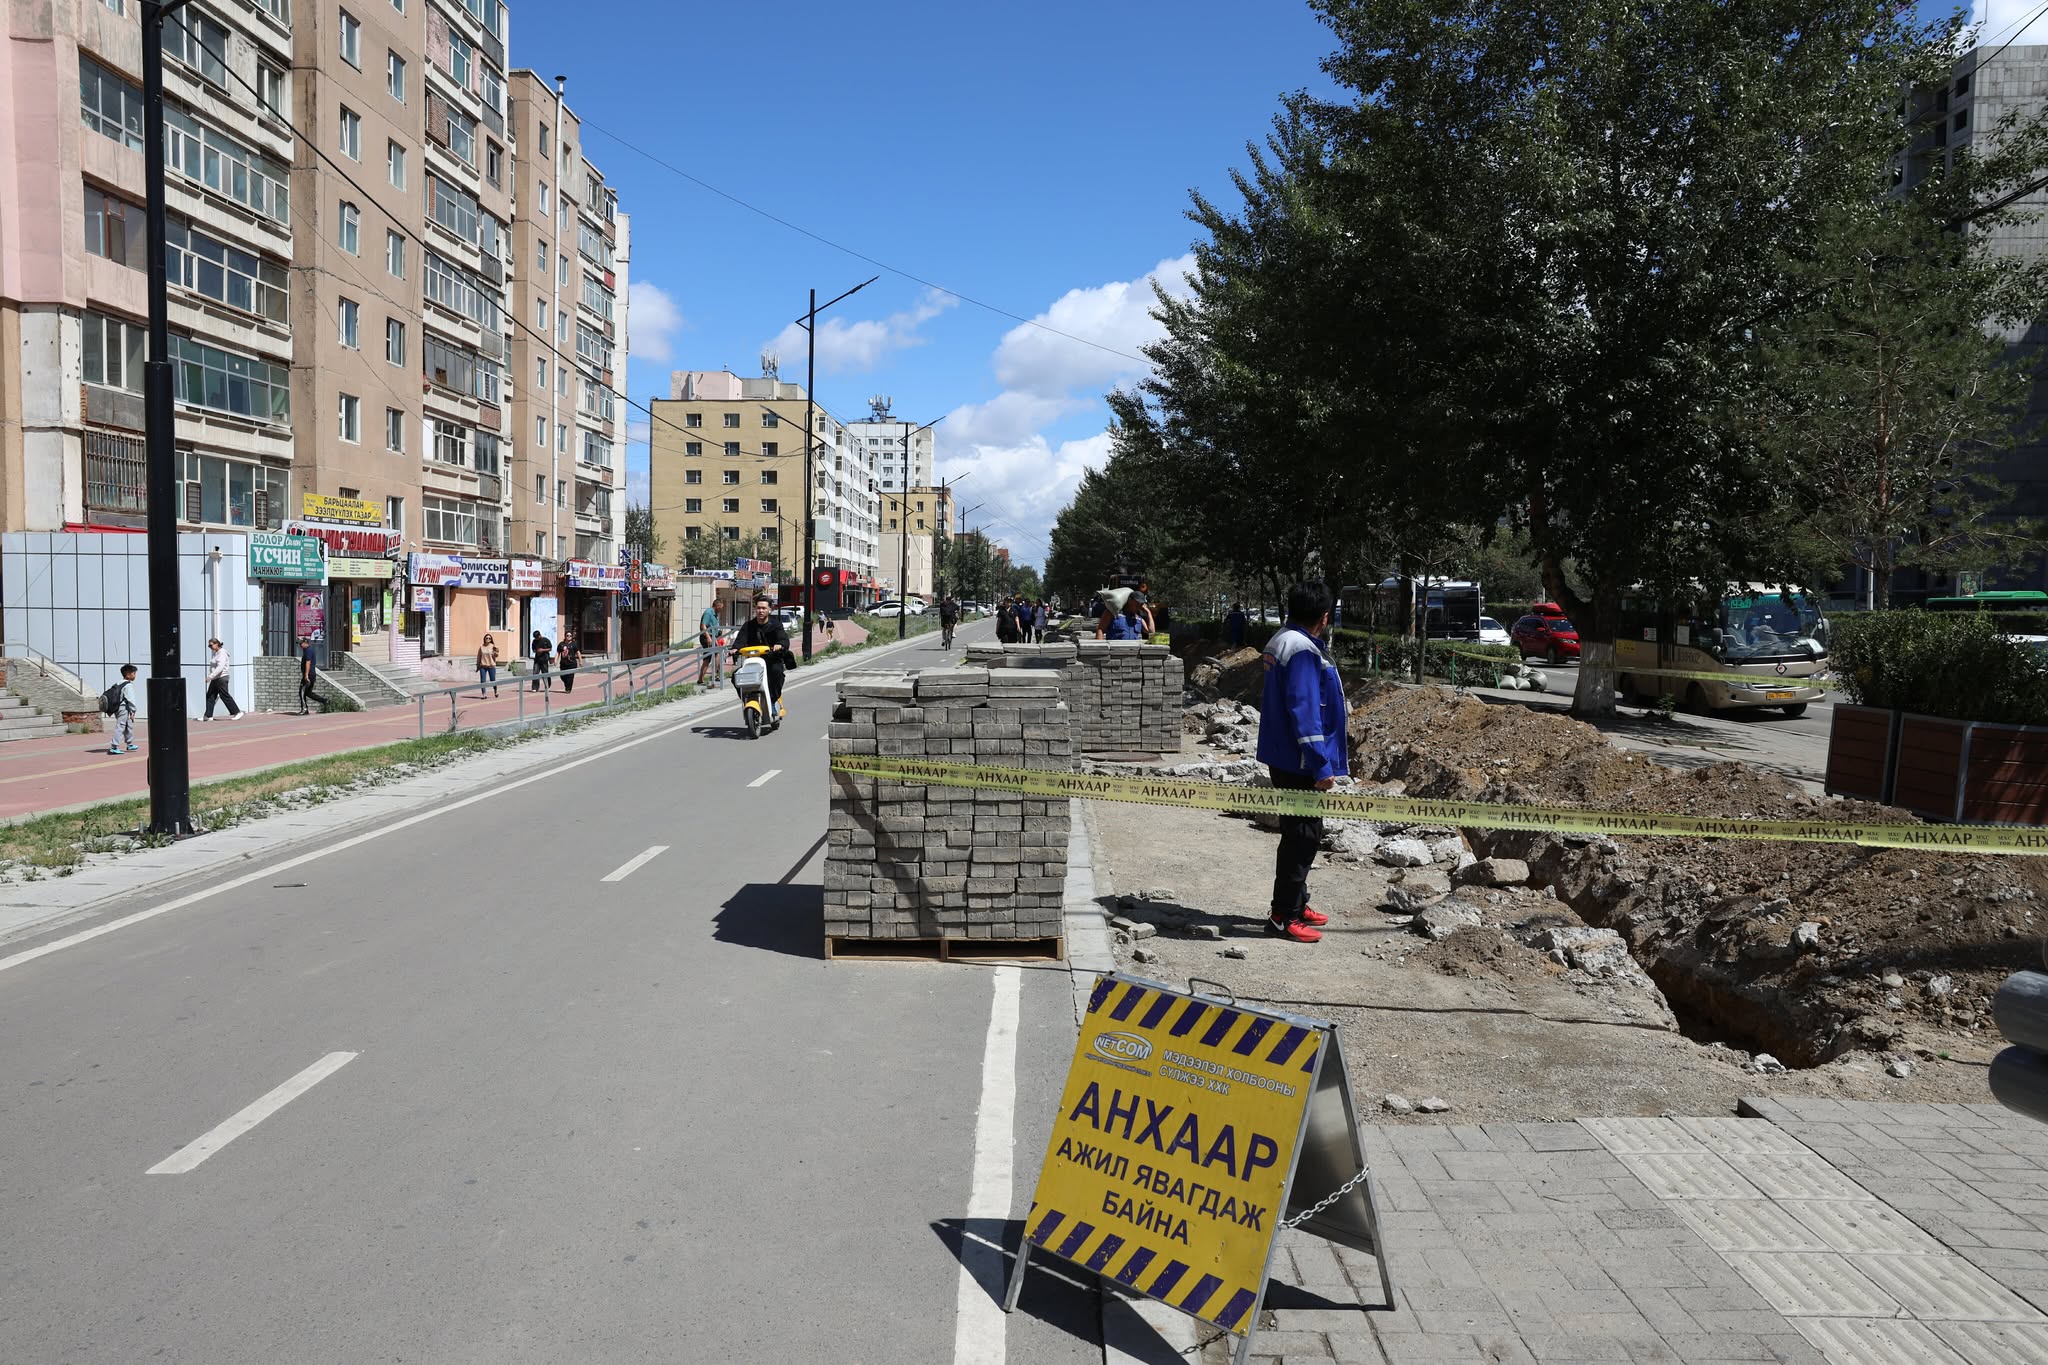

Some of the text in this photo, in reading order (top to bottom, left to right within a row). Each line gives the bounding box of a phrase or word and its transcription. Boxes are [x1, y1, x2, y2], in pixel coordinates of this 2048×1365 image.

[323, 497, 364, 509] БАРЬЦААЛАН
[354, 511, 372, 520] ГАЗАР
[253, 534, 283, 545] БОЛОР
[253, 547, 302, 565] ҮСЧИН
[253, 566, 283, 576] МАНИКЮР
[461, 572, 508, 584] УТАЛ
[631, 559, 641, 593] PUB
[897, 764, 948, 778] АНХААР
[975, 771, 1028, 785] АНХААР
[1057, 778, 1111, 792] АНХААР
[1141, 785, 1196, 799] АНХААР
[1227, 792, 1284, 806] АНХААР
[1316, 799, 1374, 813] АНХААР
[1407, 805, 1466, 819] АНХААР
[1500, 811, 1561, 825] АНХААР
[1596, 816, 1658, 830] АНХААР
[1694, 822, 1759, 835] АНХААР
[1797, 827, 1864, 841] АНХААР
[1903, 831, 1973, 845] АНХААР
[1096, 1036, 1150, 1060] NETCOM
[1162, 1049, 1225, 1076] МЭДЭЭЛЭЛ
[1226, 1067, 1296, 1097] ХОЛБООНЫ
[1159, 1065, 1206, 1088] СҮЛЖЭЭ
[1207, 1079, 1230, 1096] ХХК
[1068, 1081, 1279, 1182] АНХААР
[1055, 1136, 1267, 1232] АЖИЛ ЯВАГДАЖ
[1101, 1190, 1190, 1246] БАЙНА
